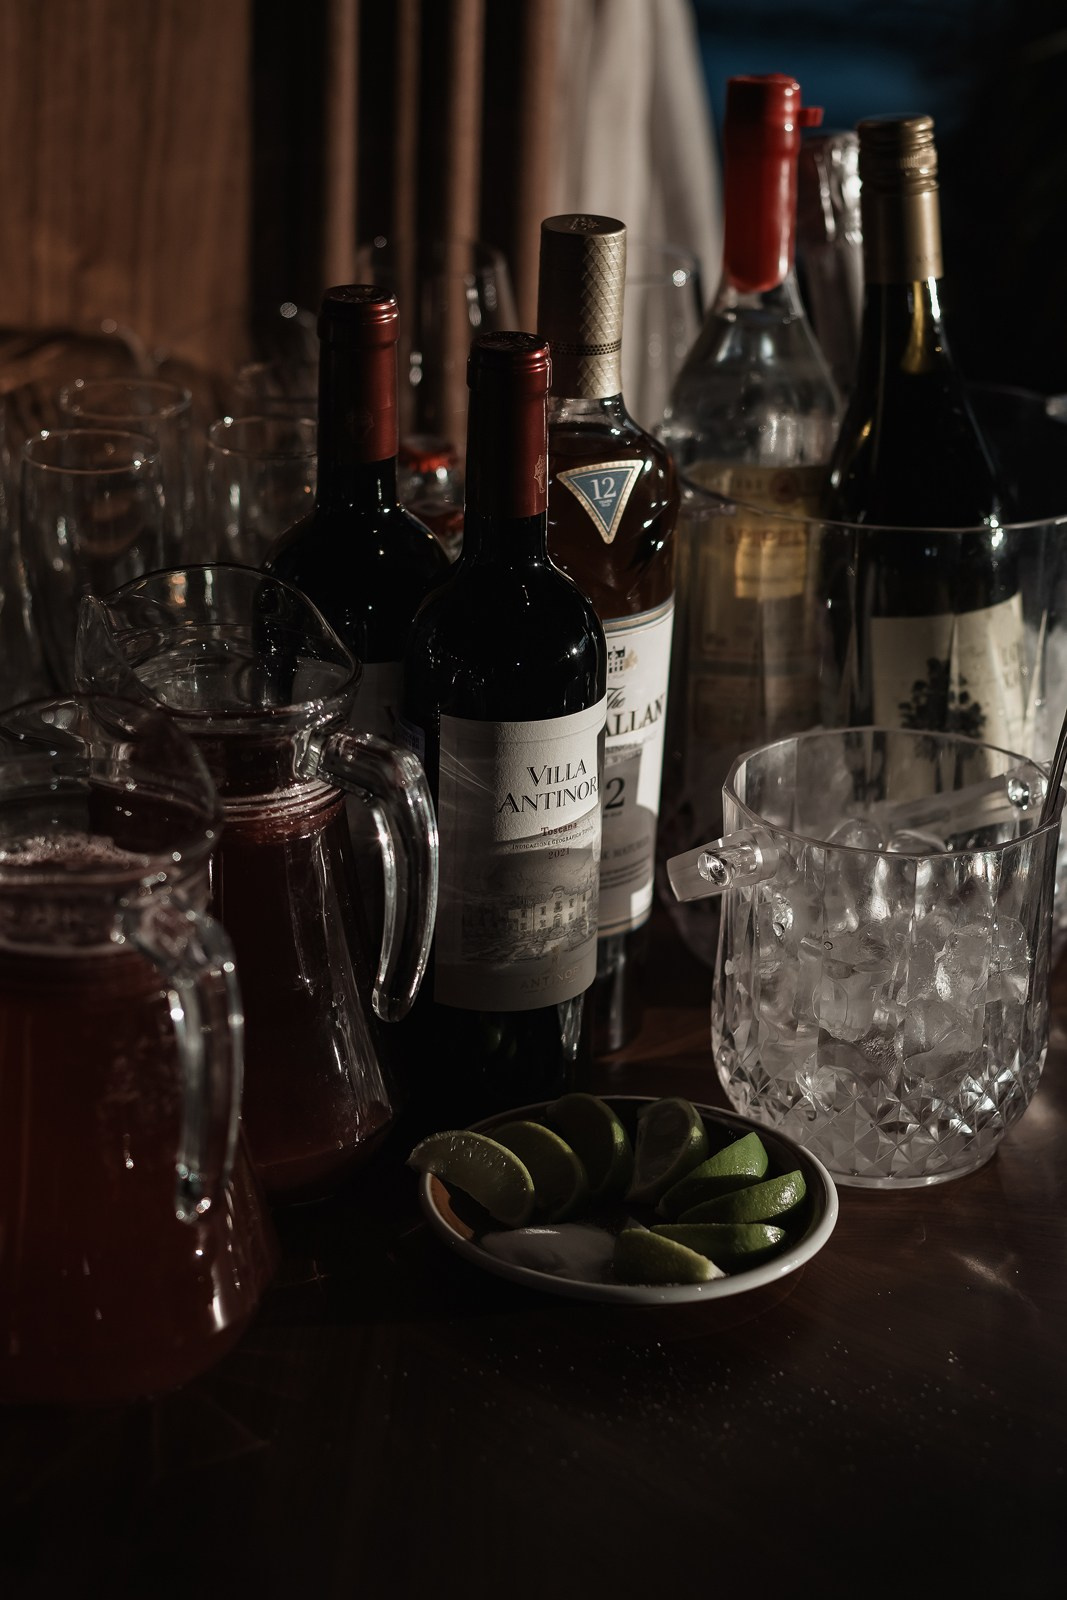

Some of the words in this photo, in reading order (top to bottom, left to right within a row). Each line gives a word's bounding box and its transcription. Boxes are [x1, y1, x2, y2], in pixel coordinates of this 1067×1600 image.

[590, 477, 617, 500] 12
[605, 692, 666, 738] ALLAN
[527, 759, 587, 787] VILLA
[605, 777, 625, 810] 2
[541, 822, 578, 836] Toscana
[548, 847, 570, 860] 2021
